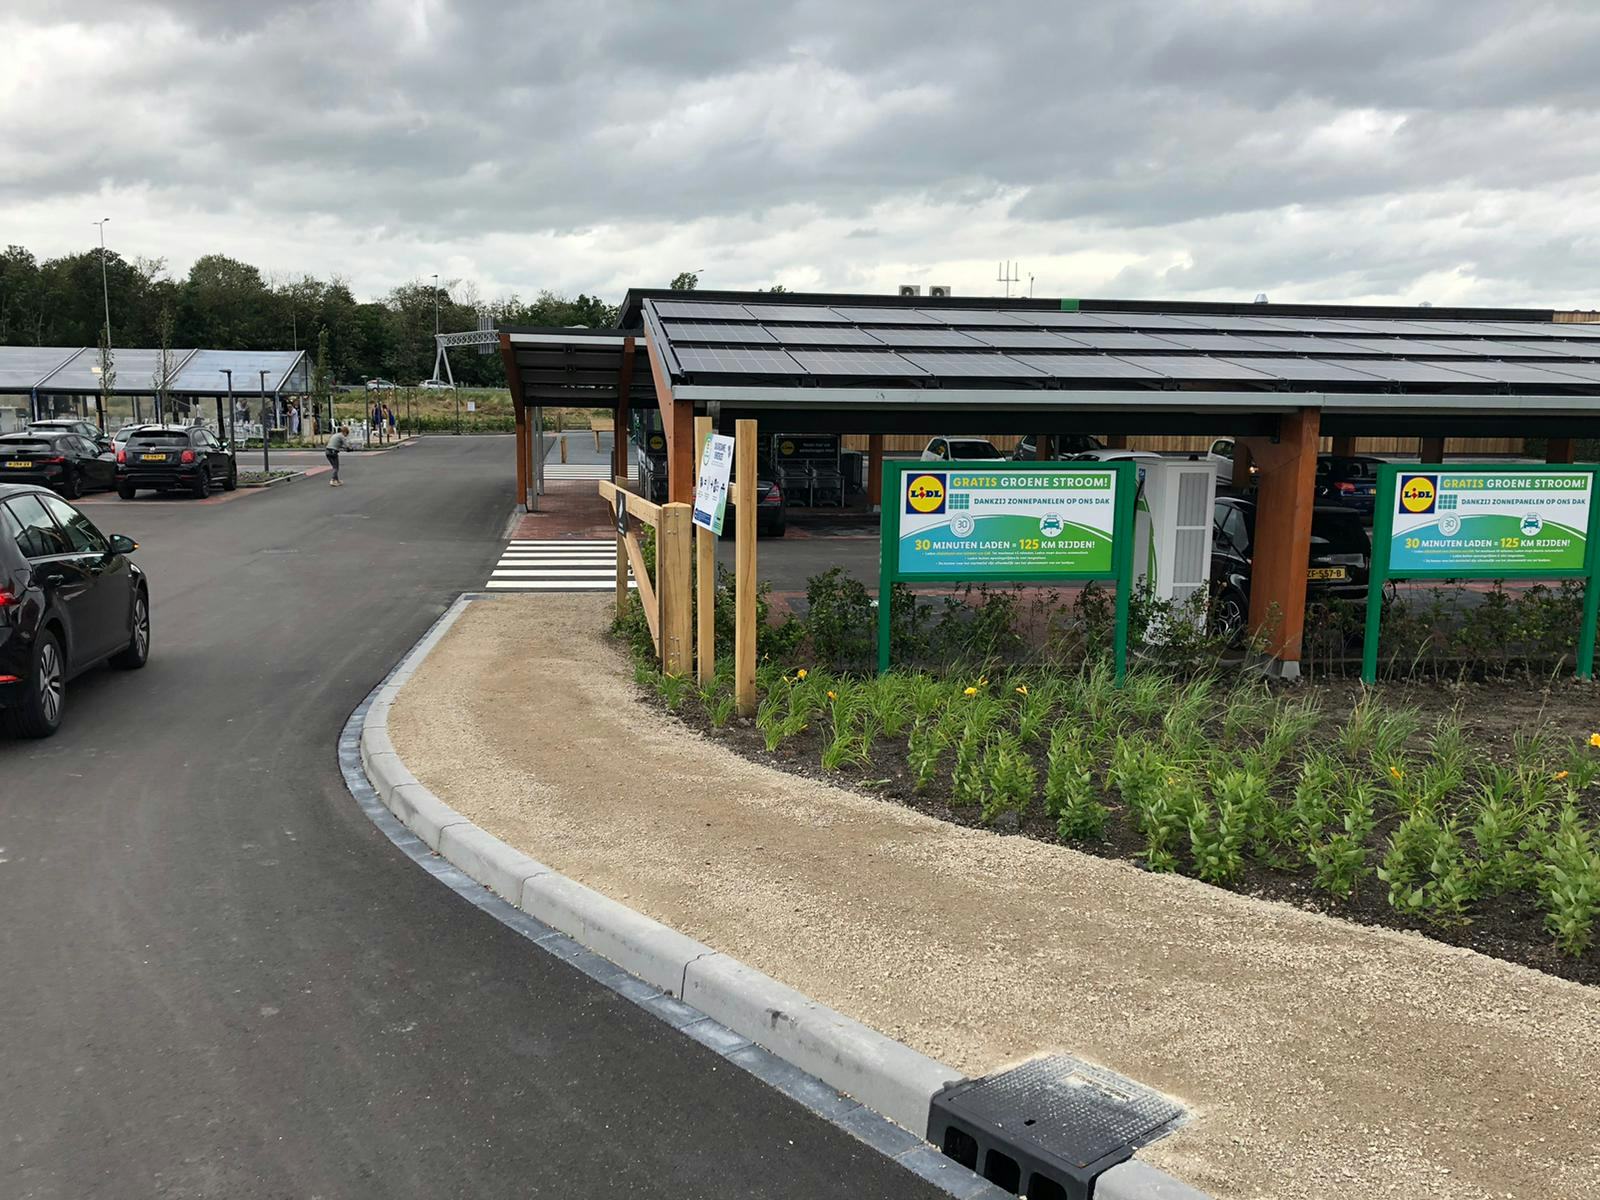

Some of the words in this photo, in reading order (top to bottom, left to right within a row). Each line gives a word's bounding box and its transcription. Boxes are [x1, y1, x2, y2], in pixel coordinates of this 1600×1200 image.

[953, 477, 997, 487] GRATIS
[1001, 477, 1049, 487] GROENE
[1053, 477, 1108, 487] STROOM!
[1443, 479, 1484, 489] GRATIS
[1487, 479, 1532, 488] GROENE
[1534, 479, 1585, 488] STROOM!
[957, 520, 968, 528] 30
[1445, 519, 1455, 528] 30
[915, 539, 931, 551] 30
[933, 541, 977, 549] MINUTEN
[979, 541, 1010, 549] LADEN
[1019, 539, 1039, 550] 125
[1041, 541, 1056, 549] KM
[1058, 541, 1096, 549] RIJDEN!
[1405, 537, 1420, 549] 30
[1421, 539, 1462, 547] MINUTEN
[1464, 539, 1492, 547] LADEN
[1500, 537, 1519, 548] 125
[1520, 539, 1535, 547] KM
[1536, 539, 1571, 547] RIJDEN!
